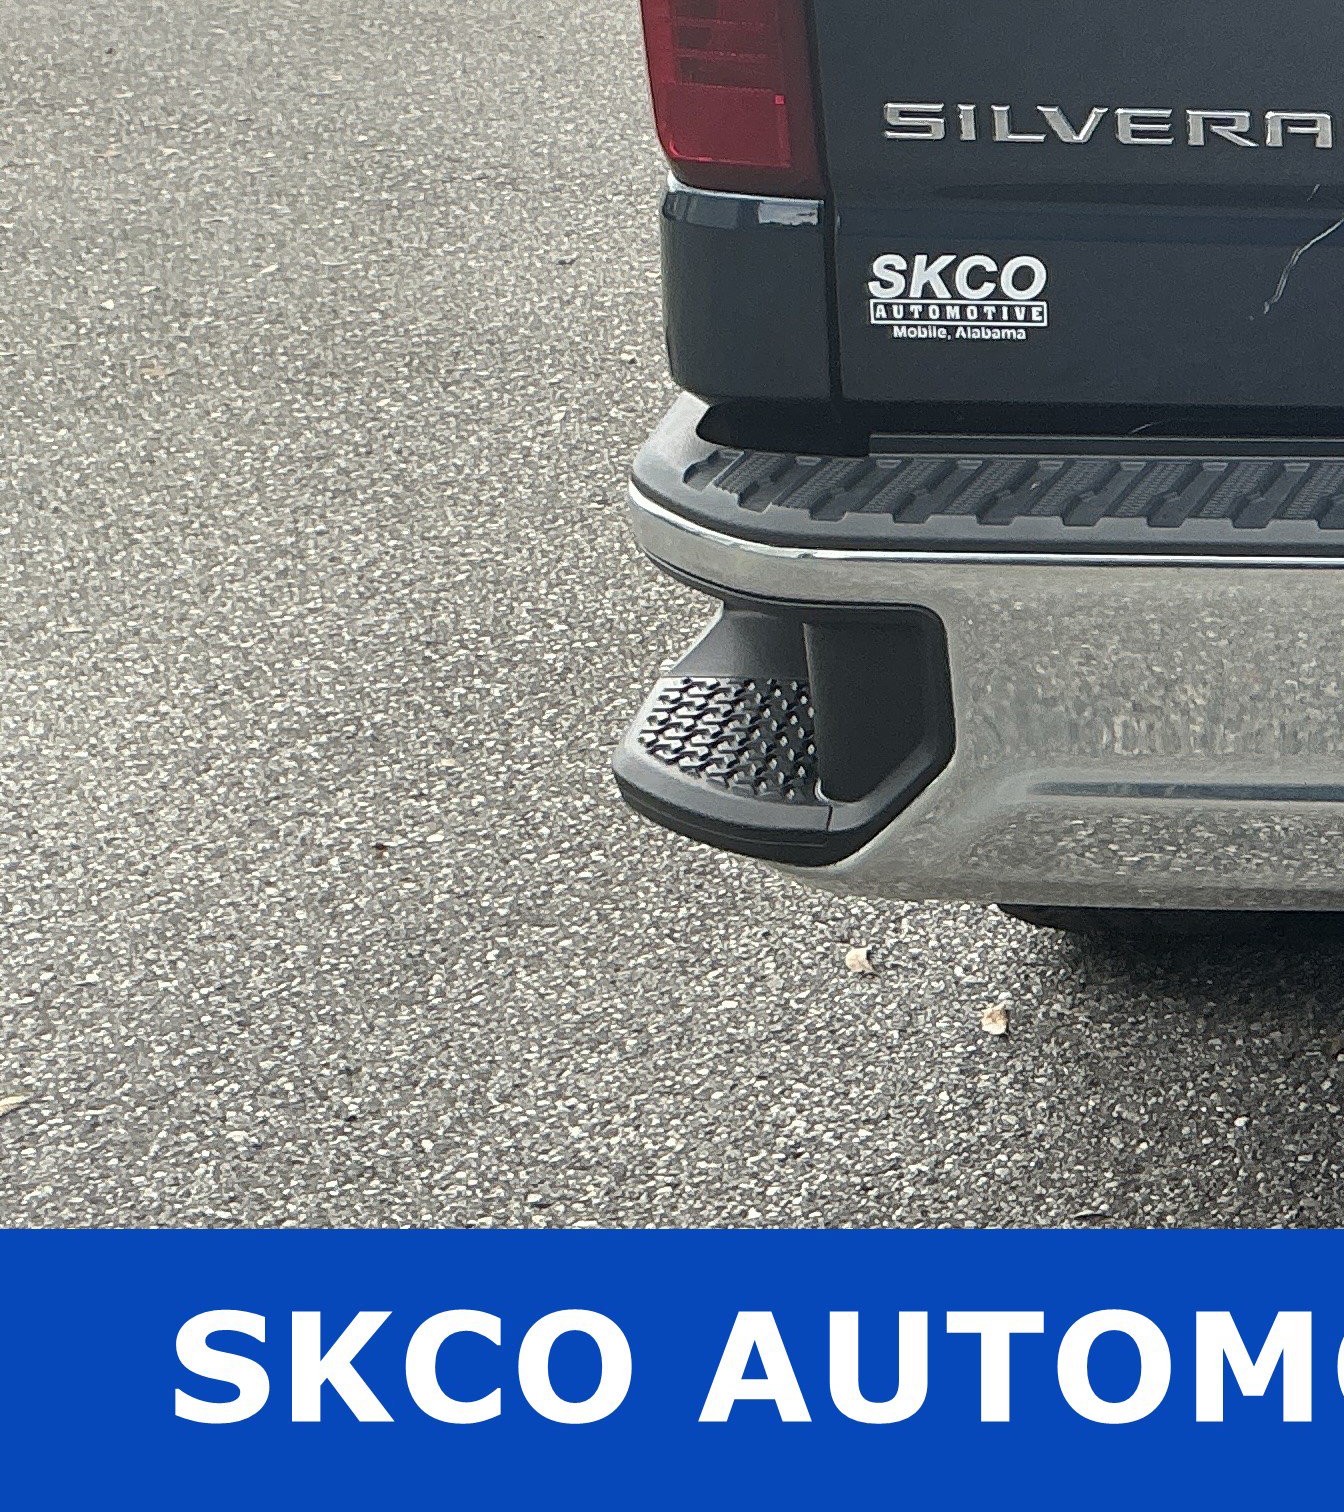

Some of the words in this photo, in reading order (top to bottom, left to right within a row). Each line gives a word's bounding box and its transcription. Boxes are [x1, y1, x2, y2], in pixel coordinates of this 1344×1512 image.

[867, 254, 1047, 300] SKCO
[875, 304, 1043, 321] AUTOMOTIVE
[893, 325, 952, 341] Mobile,
[955, 326, 1027, 340] Alabama
